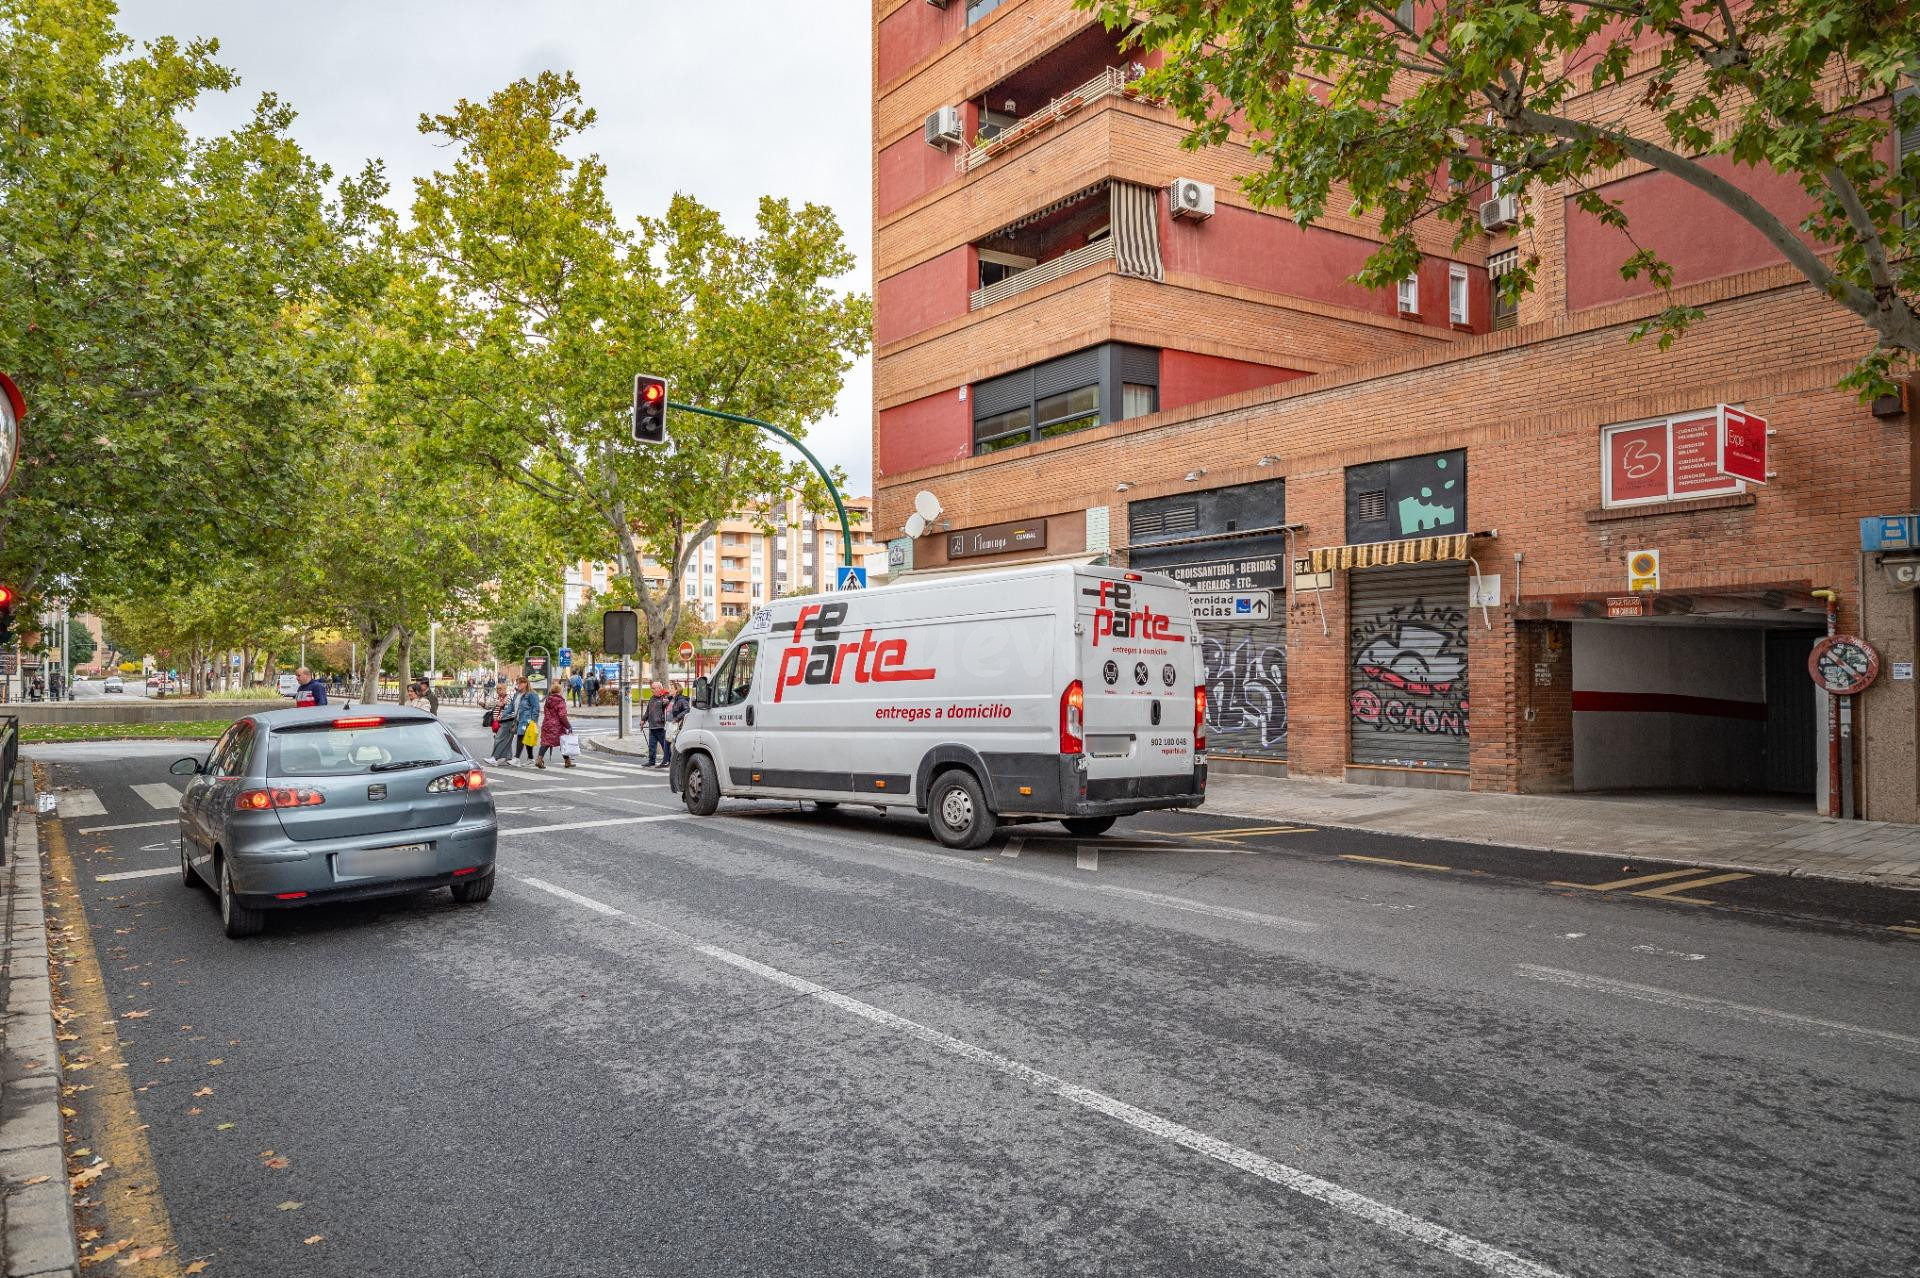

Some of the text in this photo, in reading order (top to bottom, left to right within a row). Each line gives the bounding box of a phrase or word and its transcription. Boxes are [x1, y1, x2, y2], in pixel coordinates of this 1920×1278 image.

[1240, 560, 1277, 573] BEBIDAS
[1190, 596, 1233, 604] ternidad
[1192, 606, 1231, 616] ncias
[1093, 605, 1185, 647] parte
[774, 629, 936, 703] parte
[875, 703, 1012, 722] entregas a domicilio
[1151, 738, 1162, 746] 902
